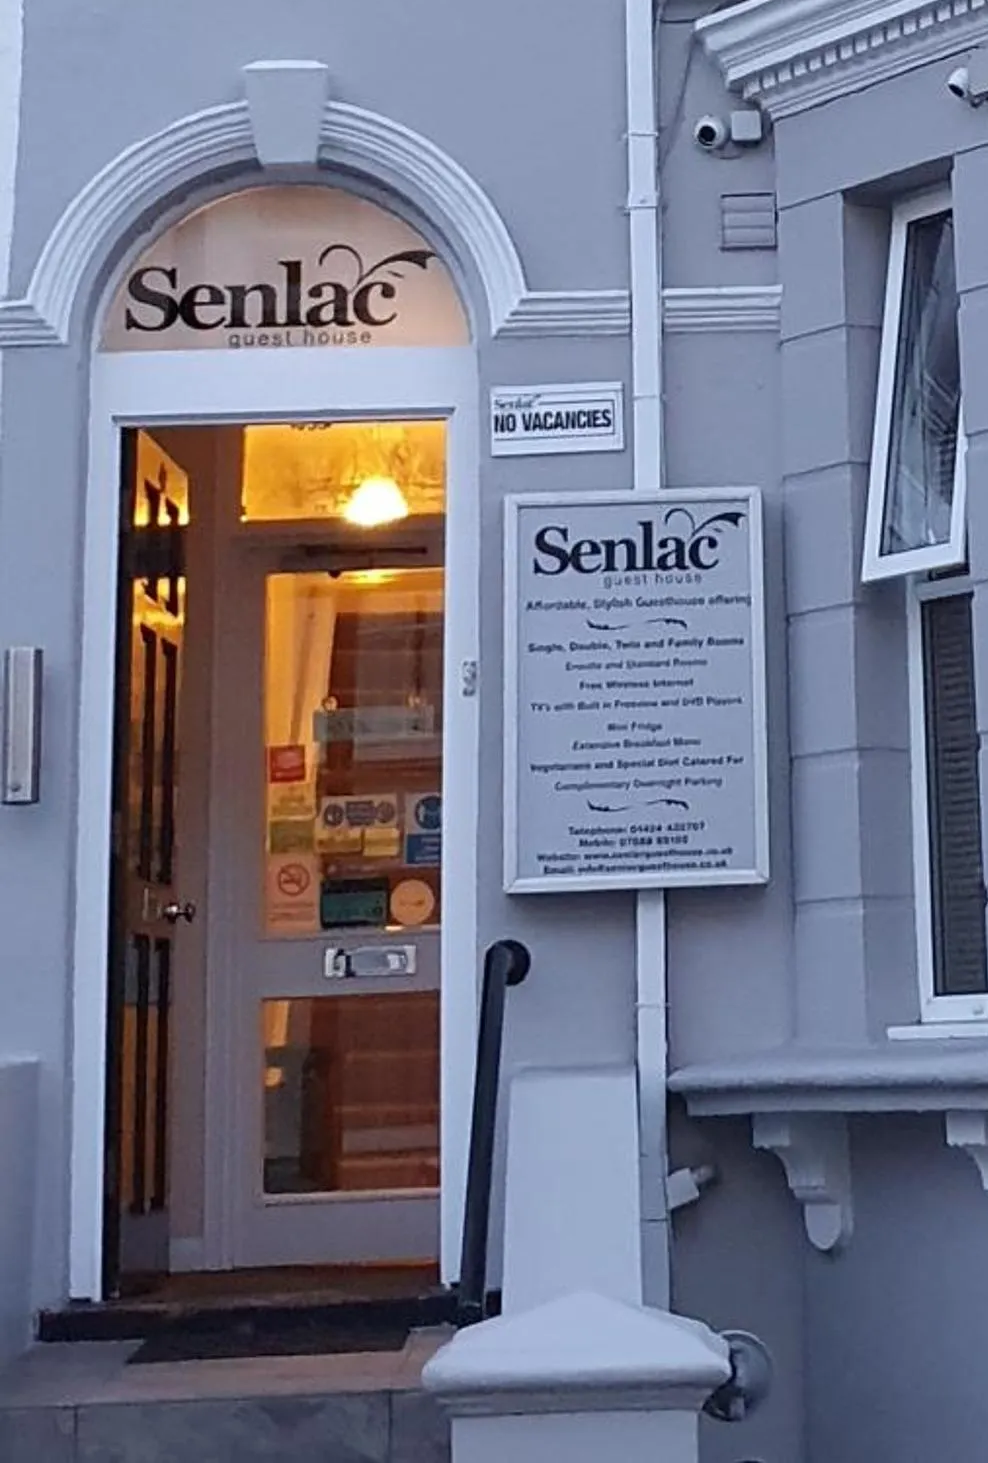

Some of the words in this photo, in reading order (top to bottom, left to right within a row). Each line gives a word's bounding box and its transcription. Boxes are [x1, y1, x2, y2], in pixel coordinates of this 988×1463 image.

[125, 260, 399, 332] Senlac
[228, 329, 293, 348] guest
[304, 329, 372, 346] house
[494, 414, 517, 433] NO
[521, 409, 612, 431] VACANCIES
[532, 520, 720, 576] Senlac
[603, 574, 648, 589] guest
[655, 572, 702, 585] house
[708, 595, 751, 607] offering
[616, 639, 640, 649] Twin
[644, 639, 664, 648] and
[668, 638, 703, 648] Family
[707, 637, 745, 646] Rooms
[578, 680, 602, 690] Free
